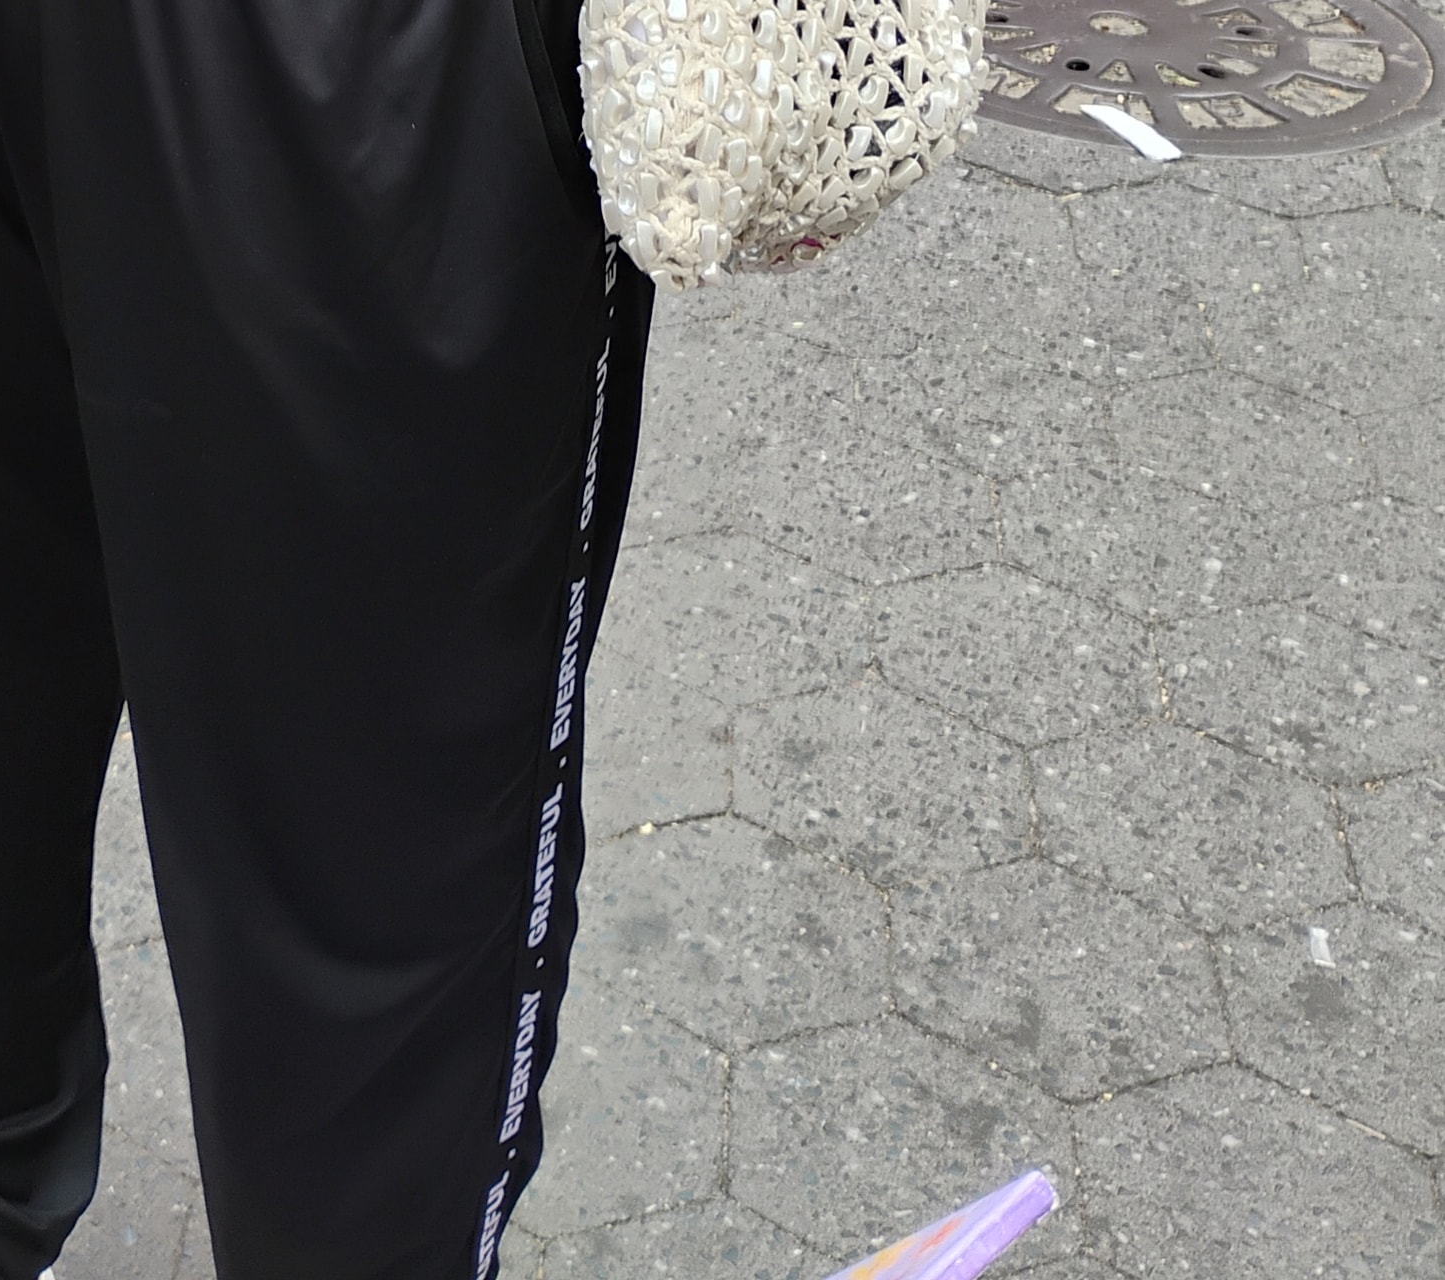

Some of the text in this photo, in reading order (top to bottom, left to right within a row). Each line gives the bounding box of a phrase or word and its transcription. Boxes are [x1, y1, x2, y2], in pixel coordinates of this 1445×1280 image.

[499, 990, 541, 1144] EVERYDAY
[527, 782, 563, 948] GRATEFUL
[549, 576, 586, 751] EVERYDAY
[579, 337, 611, 531] GRATEFUL
